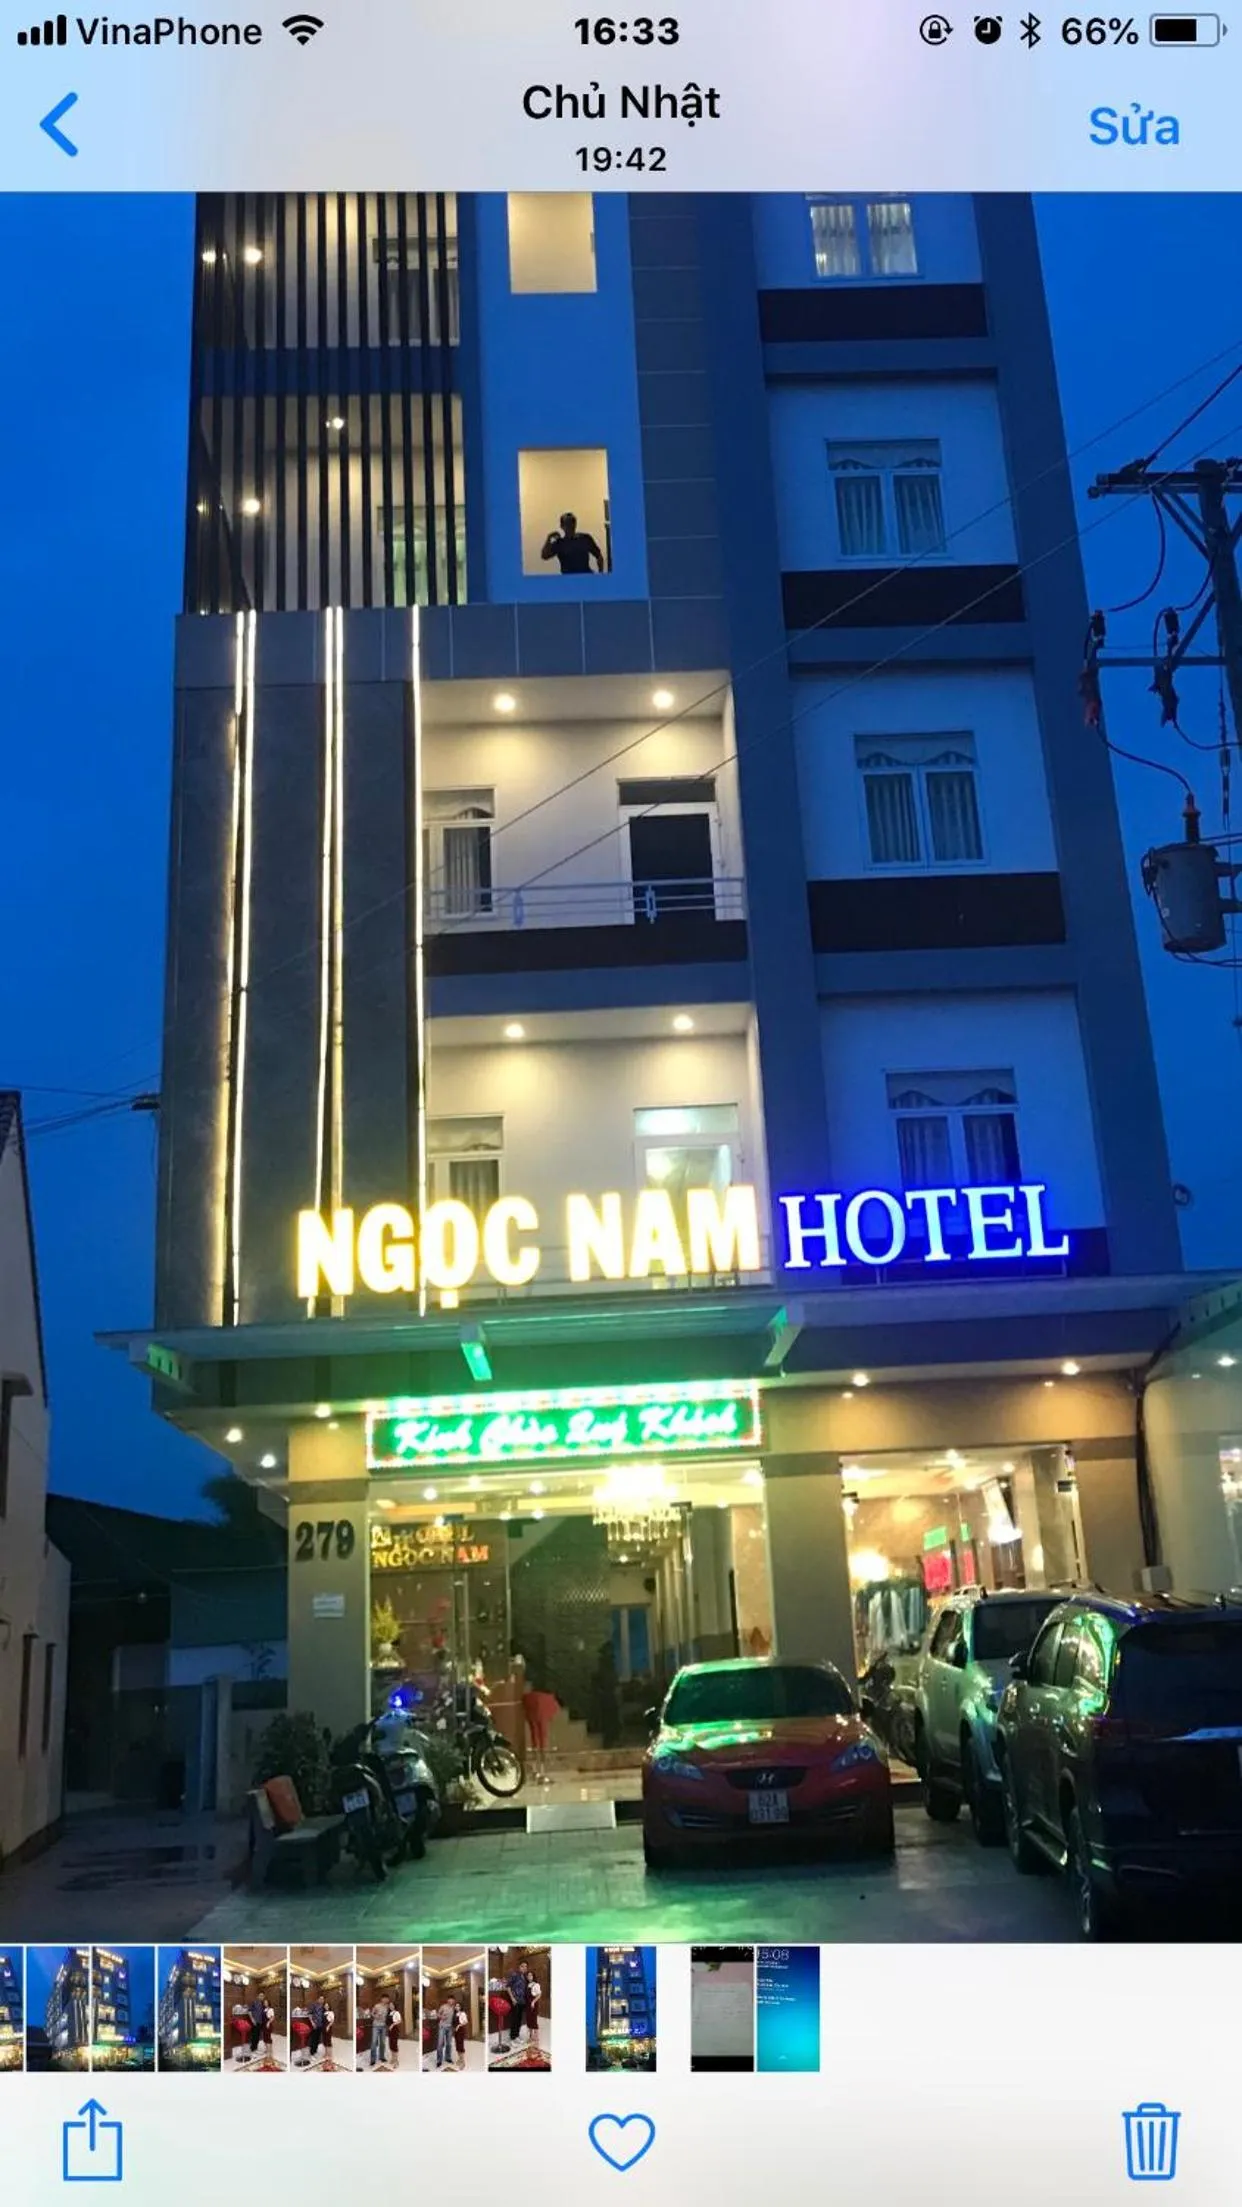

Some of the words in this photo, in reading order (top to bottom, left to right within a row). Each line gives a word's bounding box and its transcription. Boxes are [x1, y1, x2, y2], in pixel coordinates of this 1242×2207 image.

[297, 1196, 540, 1309] NGỌC
[567, 1184, 761, 1283] NAM
[779, 1184, 1070, 1269] HOTEL
[294, 1518, 355, 1563] 279
[440, 1545, 489, 1565] NAM
